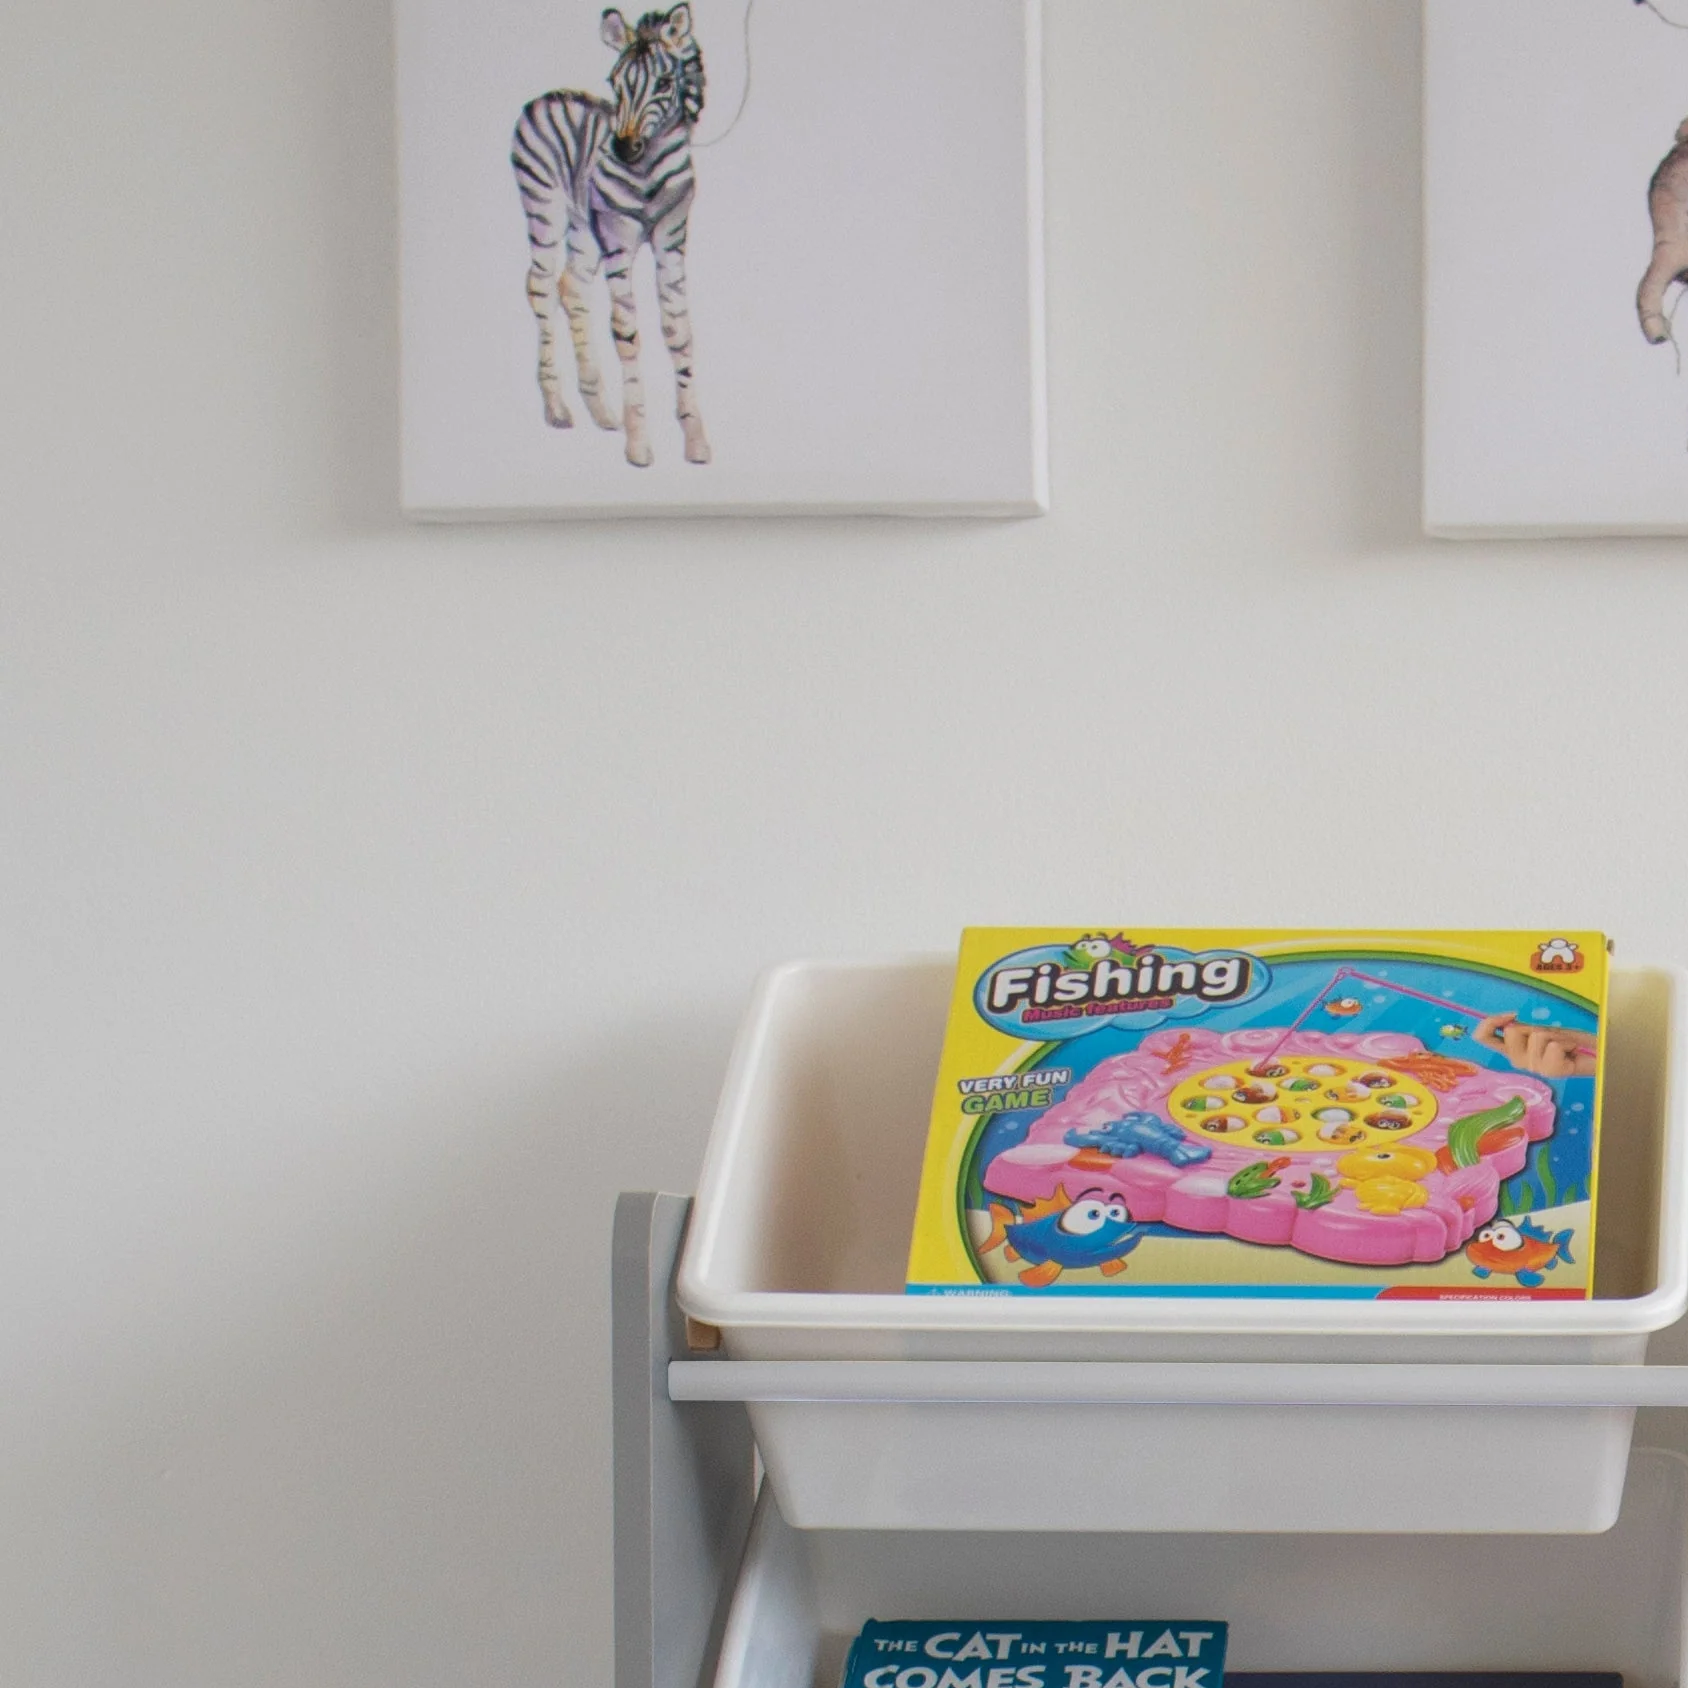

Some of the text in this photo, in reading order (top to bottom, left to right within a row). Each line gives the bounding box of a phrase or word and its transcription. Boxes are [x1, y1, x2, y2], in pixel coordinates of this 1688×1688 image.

[990, 953, 1243, 1009] Fishing
[1023, 998, 1174, 1023] Music features
[960, 1070, 1069, 1094] VERY FUN
[964, 1089, 1050, 1114] GAME
[874, 1628, 1215, 1662] THE CAT IN THE HAT
